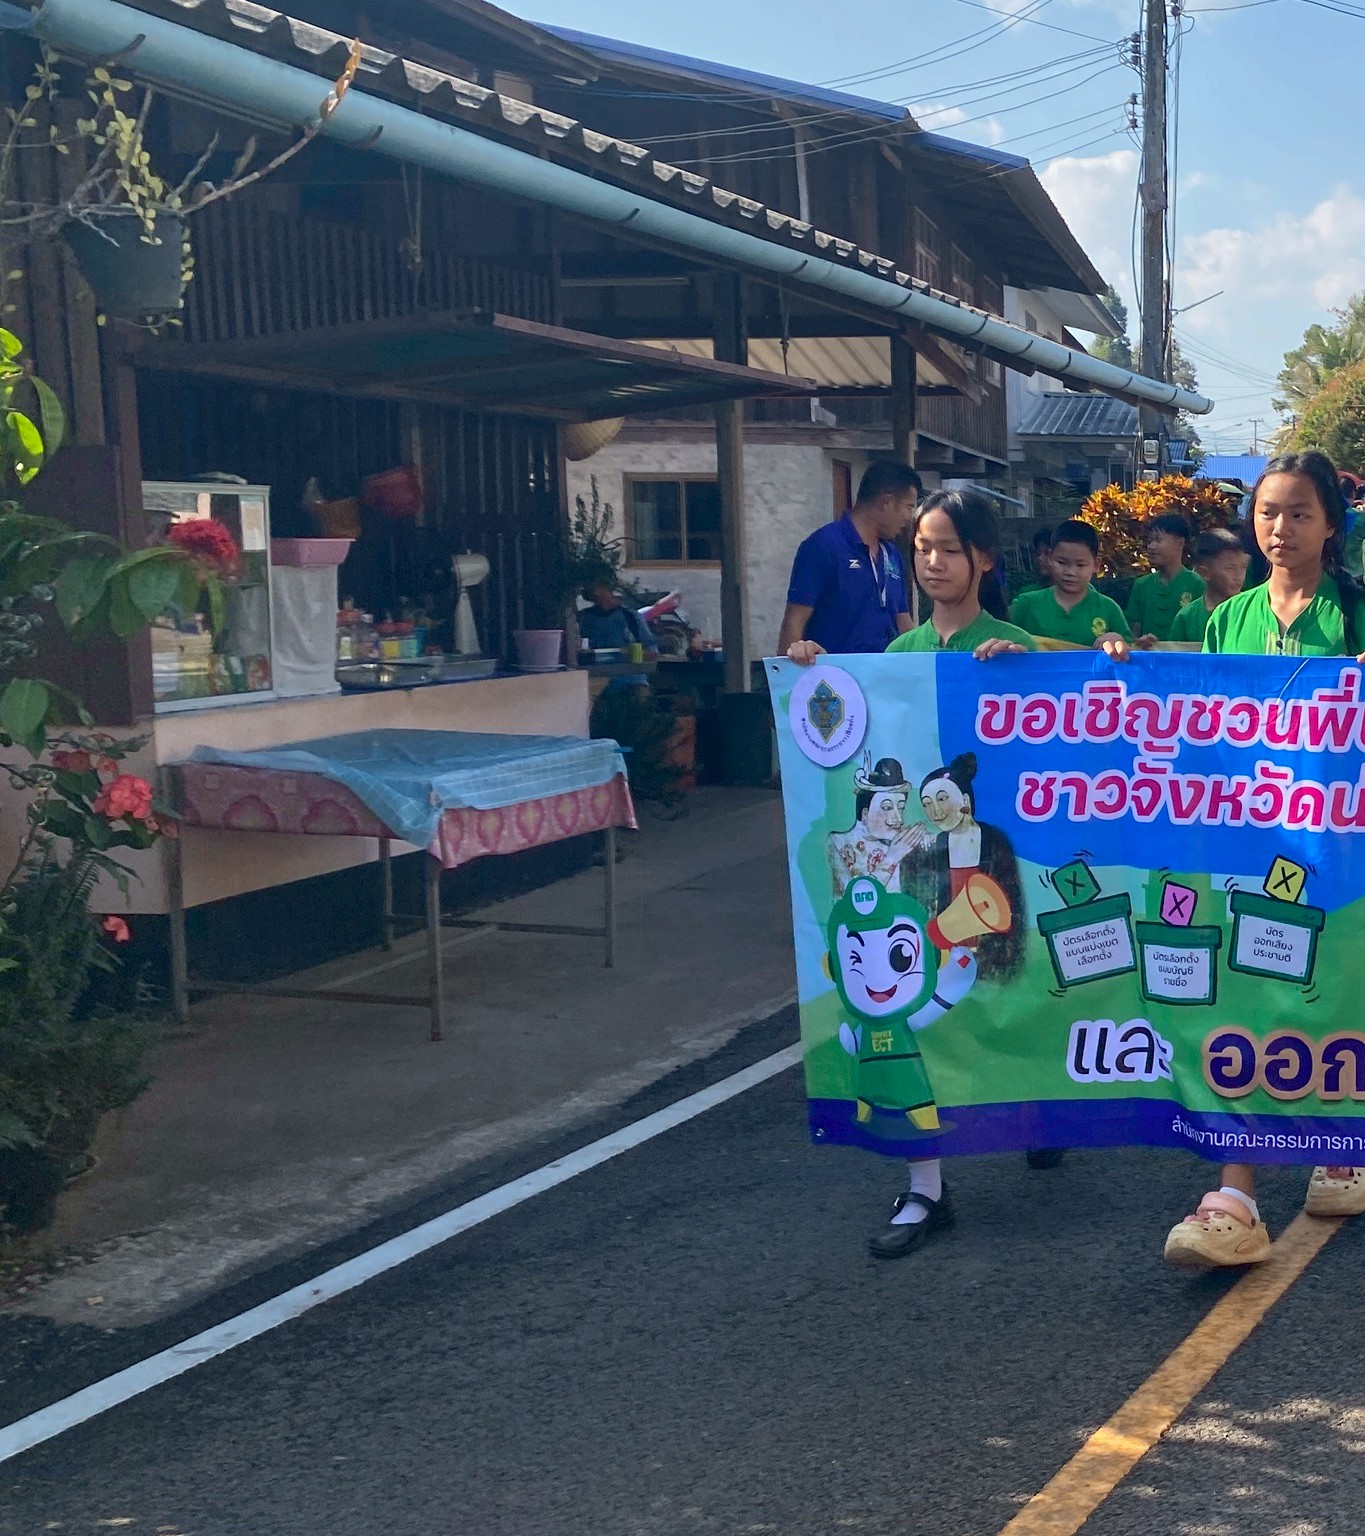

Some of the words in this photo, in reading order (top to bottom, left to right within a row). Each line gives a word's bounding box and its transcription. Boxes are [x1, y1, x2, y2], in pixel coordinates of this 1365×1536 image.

[1062, 924, 1117, 946] บัตรเลือกตั้ง
[1265, 926, 1284, 938] บัตร
[1065, 938, 1119, 957] แบบแบ่งเขต
[1253, 936, 1293, 951] ออกเสียง
[1077, 949, 1113, 966] เลือกตั้ง
[1152, 951, 1200, 964] บัตรเลือกตั้ง
[1253, 948, 1292, 963] ประชามติ
[1073, 1026, 1171, 1076] และ
